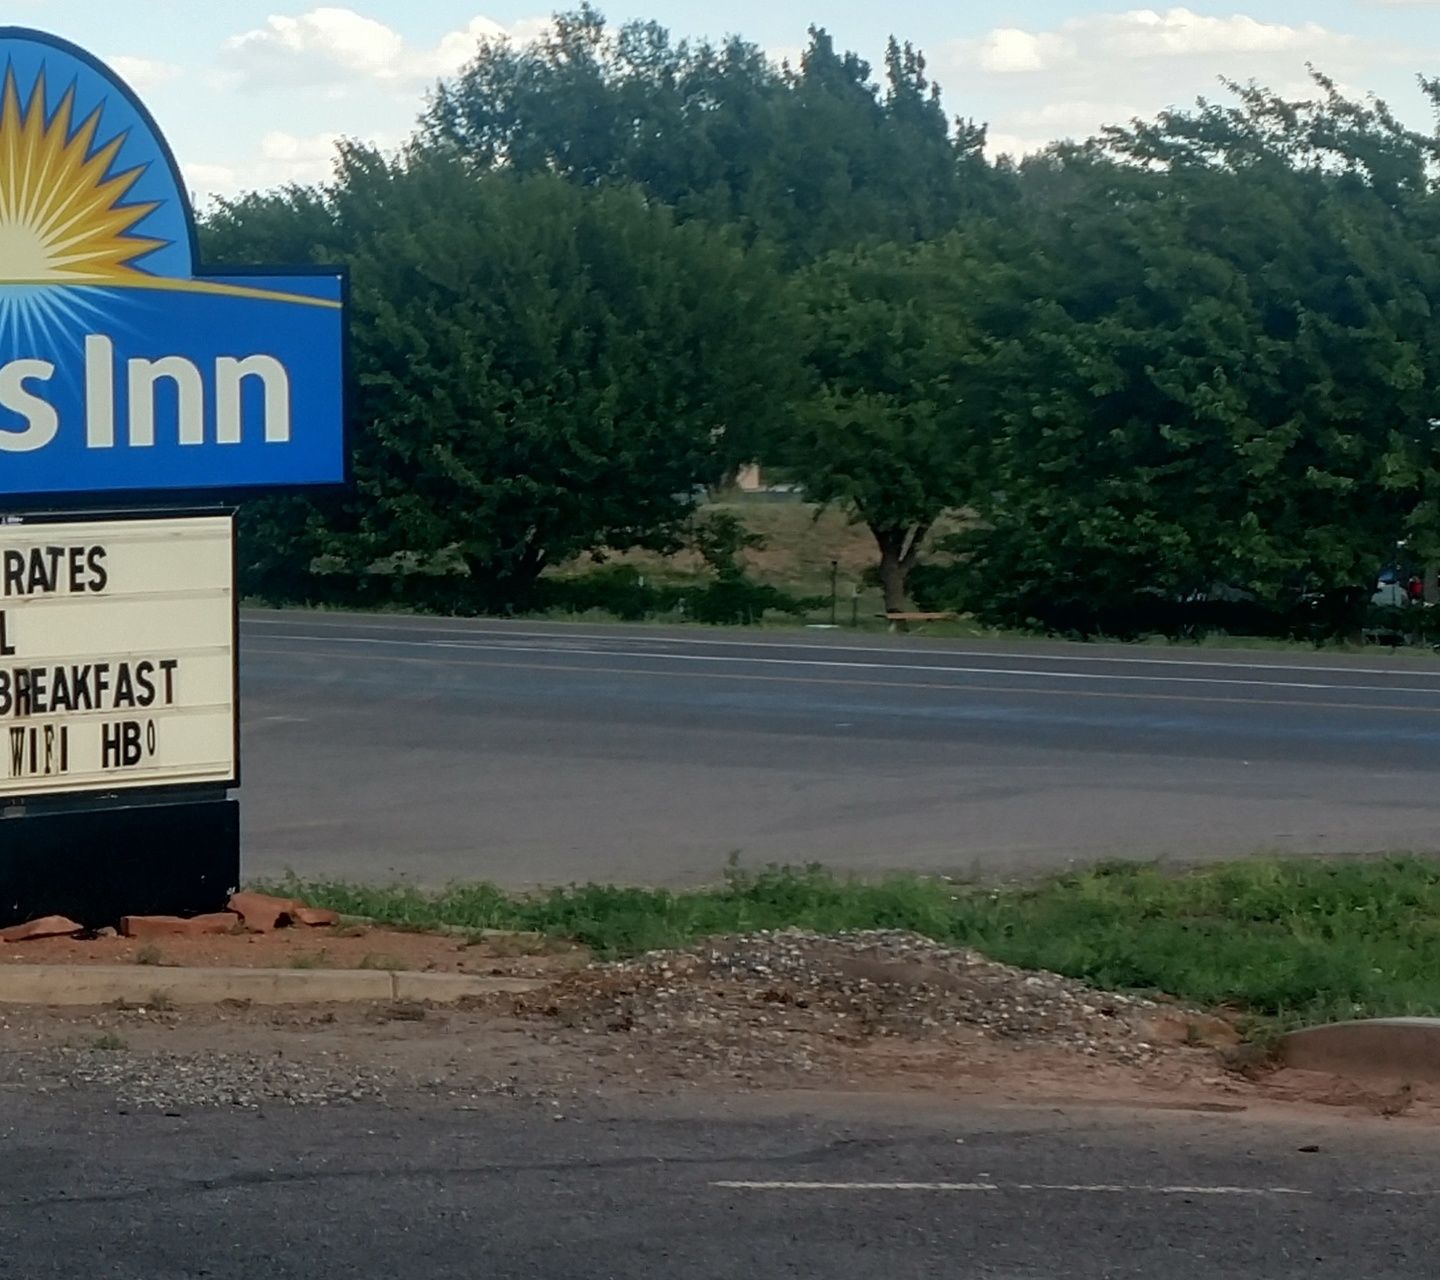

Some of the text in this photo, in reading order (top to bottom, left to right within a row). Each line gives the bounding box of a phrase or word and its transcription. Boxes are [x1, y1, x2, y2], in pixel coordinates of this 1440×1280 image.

[84, 334, 291, 448] Inn
[4, 545, 108, 596] RATES
[102, 719, 156, 768] HBO
